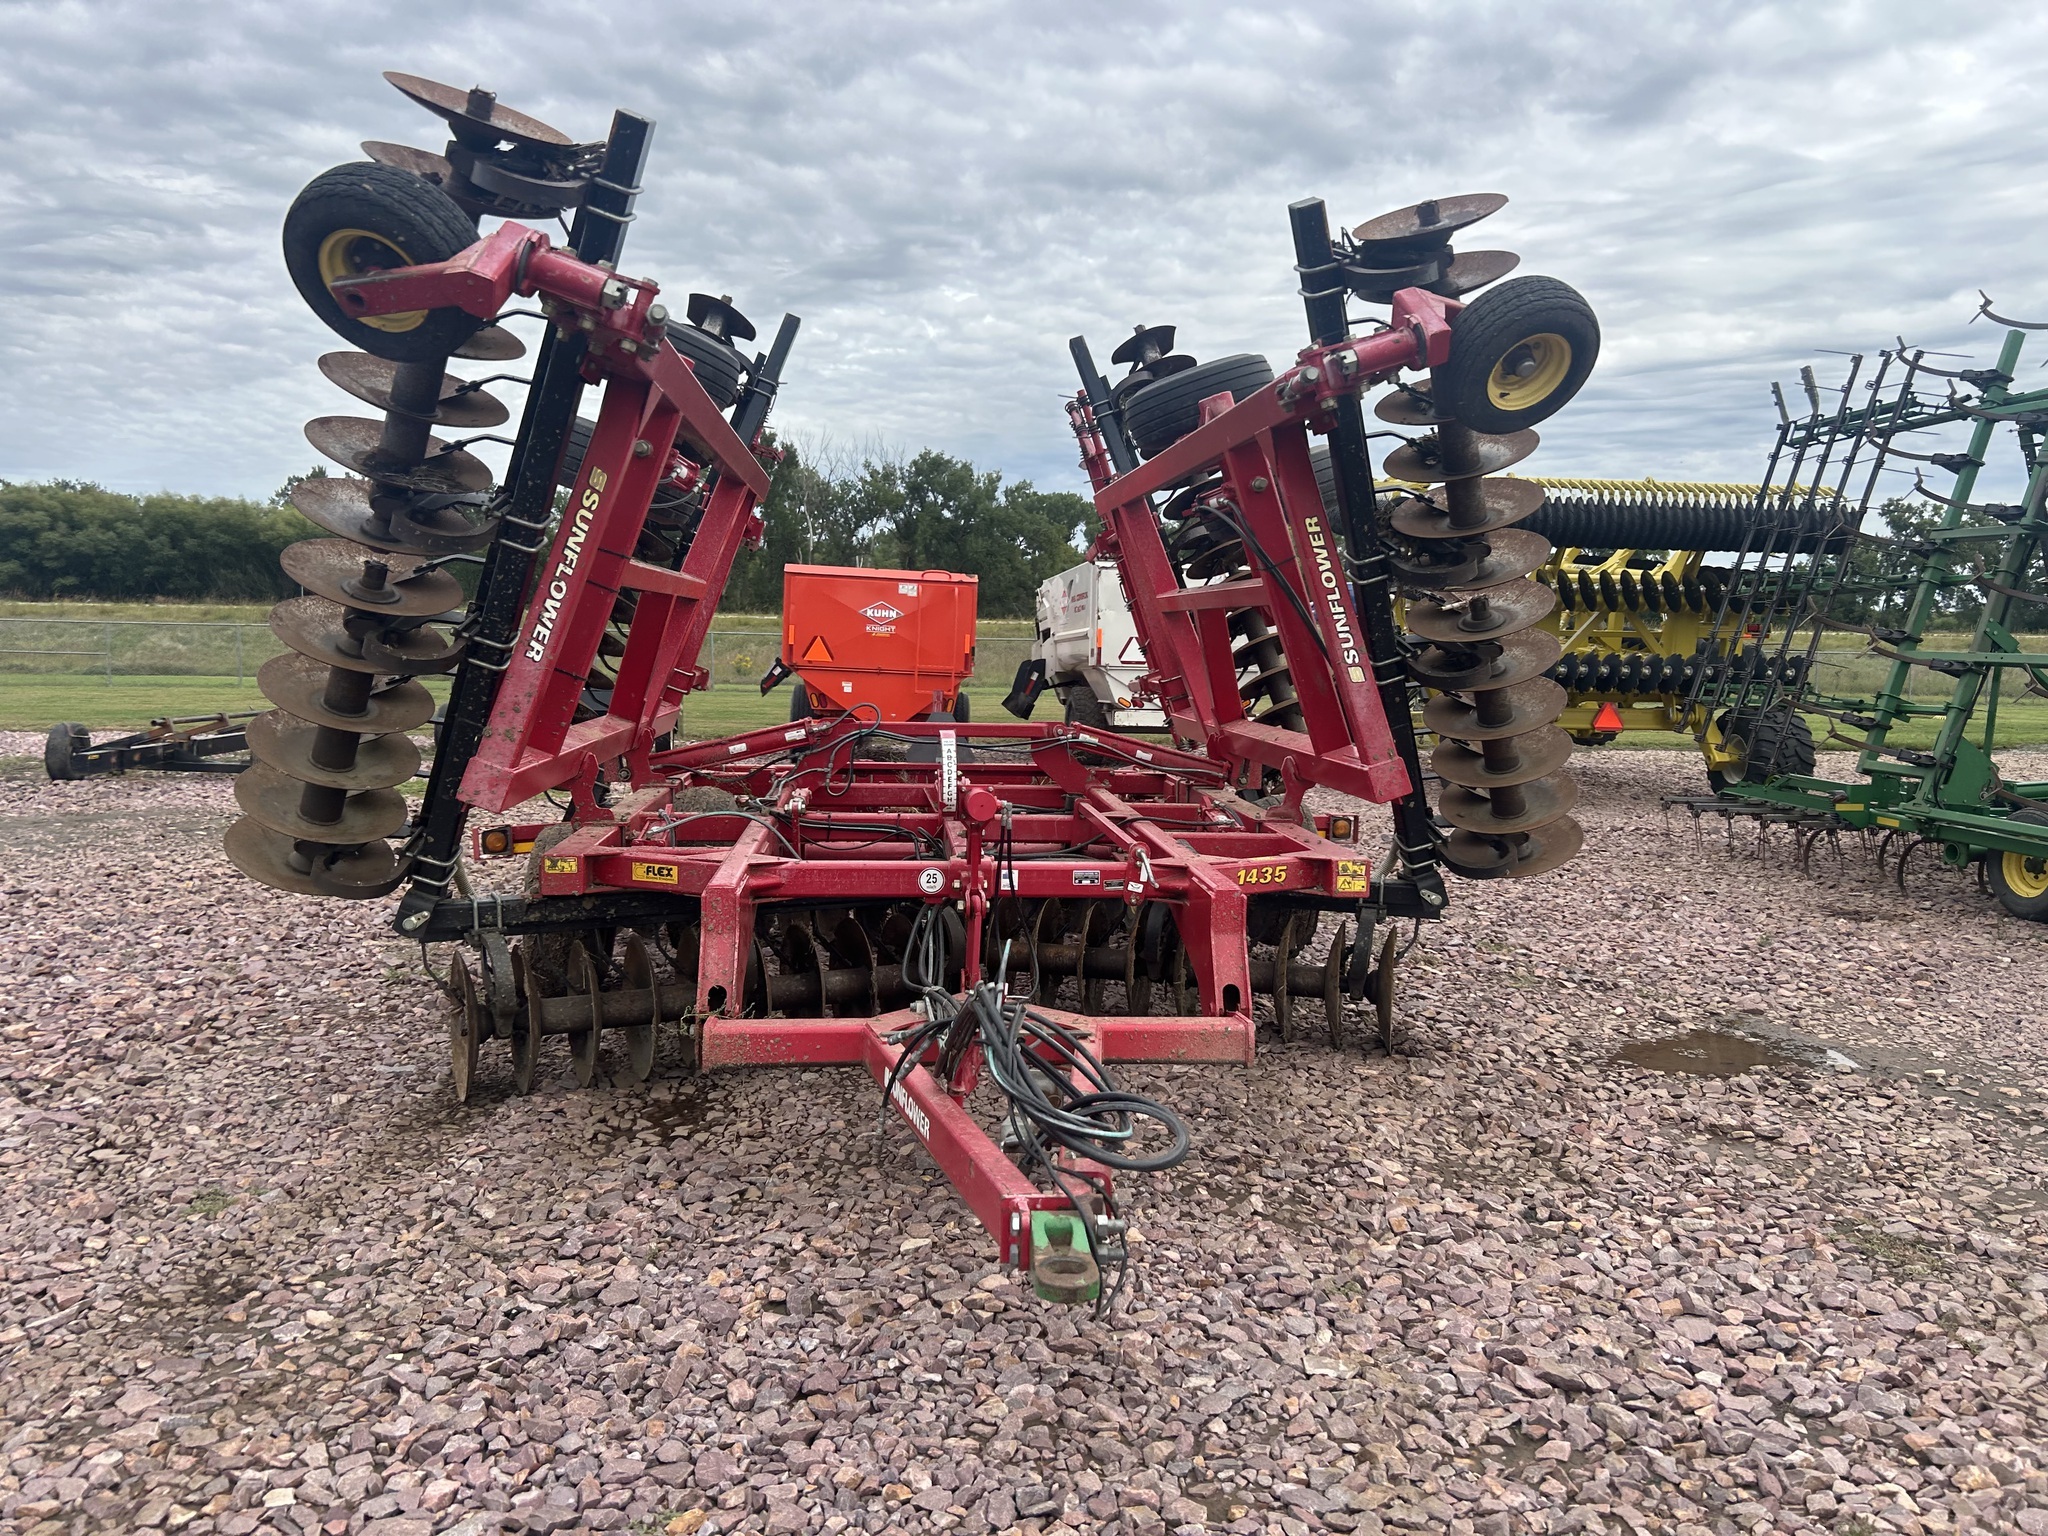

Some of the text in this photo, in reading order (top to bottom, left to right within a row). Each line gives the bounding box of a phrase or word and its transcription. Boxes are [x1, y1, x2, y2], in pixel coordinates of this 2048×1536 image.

[525, 486, 601, 664] SUNFLOWER
[1303, 515, 1361, 666] SUNFLOWER
[866, 609, 897, 618] KUHN
[866, 625, 896, 633] KNIGHT
[926, 873, 938, 884] 25
[1237, 865, 1288, 885] 1435
[889, 1070, 930, 1142] UNFLOWER
